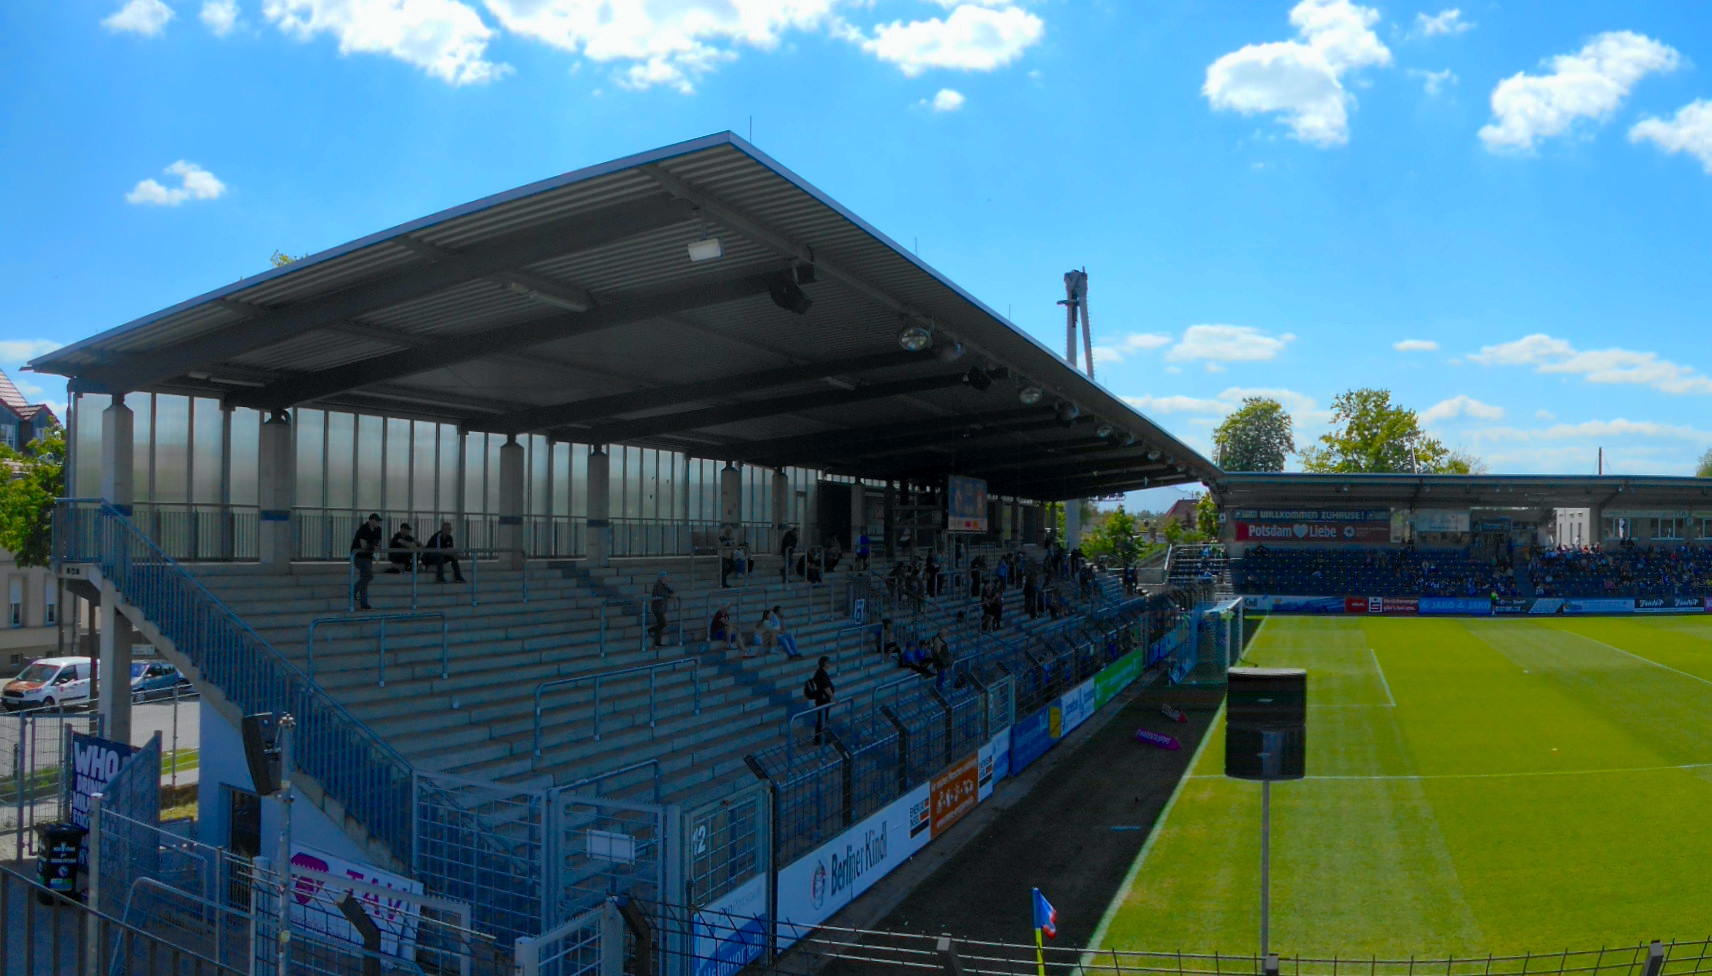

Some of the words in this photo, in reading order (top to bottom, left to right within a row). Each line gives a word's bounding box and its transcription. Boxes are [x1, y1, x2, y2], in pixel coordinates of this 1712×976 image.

[1260, 511, 1318, 519] WILLKOMMEN
[1321, 511, 1364, 520] ZUHAUSE!
[1248, 524, 1292, 537] Potsdam
[1309, 524, 1337, 537] Liebe
[1431, 601, 1454, 609] JAKO
[1468, 601, 1490, 609] JAKO
[74, 741, 119, 783] WHO
[831, 844, 864, 896] Berliner
[865, 820, 887, 871] Kindl
